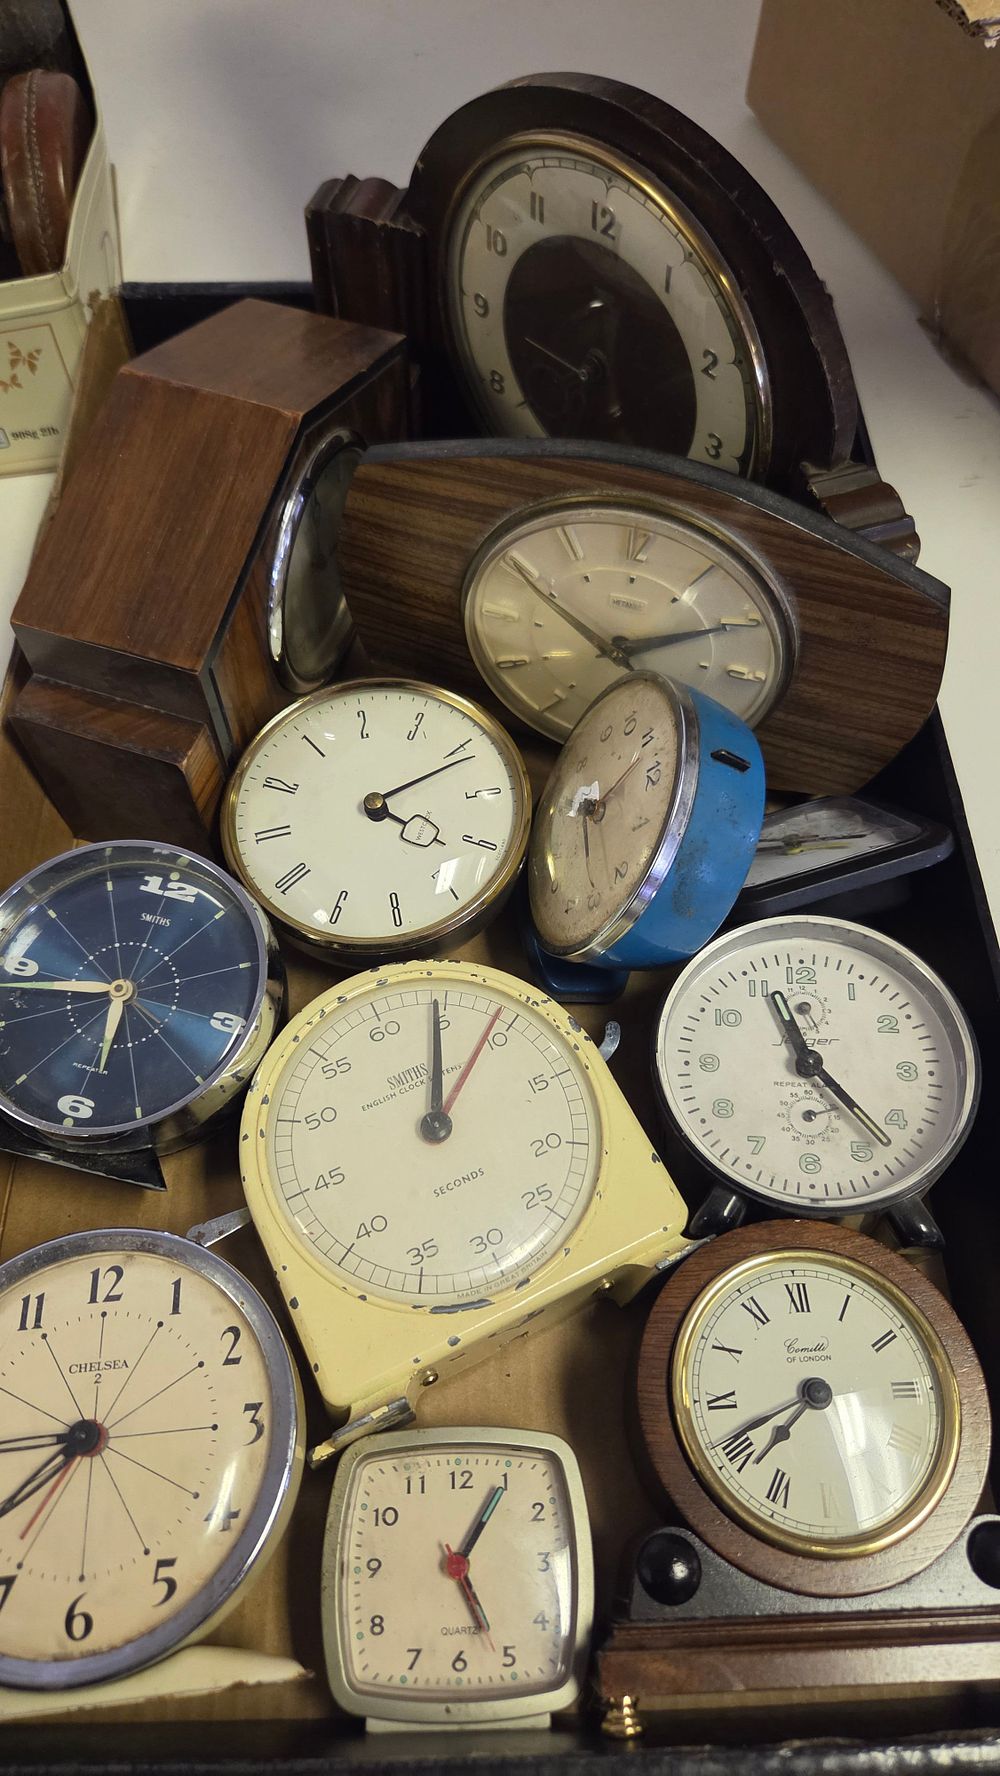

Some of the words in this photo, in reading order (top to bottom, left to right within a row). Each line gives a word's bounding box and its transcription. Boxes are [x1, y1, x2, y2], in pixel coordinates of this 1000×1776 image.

[530, 191, 545, 225] 11
[591, 199, 617, 241] 12
[486, 223, 508, 257] 10
[664, 263, 673, 295] 1
[474, 292, 490, 318] 9
[702, 349, 718, 380] 2
[490, 369, 505, 393] 8
[704, 432, 723, 460] 3
[357, 710, 370, 740] 2
[407, 712, 424, 741] 3
[600, 725, 613, 743] 9
[624, 710, 637, 736] 10
[301, 735, 326, 758] 1
[443, 738, 472, 760] 4
[641, 728, 654, 748] 11
[262, 776, 299, 795] 12
[646, 760, 662, 792] 12
[465, 787, 502, 799] 5
[254, 825, 291, 844] 11
[462, 834, 498, 851] 6
[275, 862, 312, 895] 10
[613, 861, 629, 884] 2
[139, 874, 200, 903] 12
[329, 890, 348, 925] 9
[389, 892, 403, 928] 8
[140, 912, 172, 927] SMITHS
[4, 956, 39, 977] 9
[786, 966, 817, 984] 12
[748, 979, 769, 998] 11
[847, 982, 856, 1001] 1
[209, 1011, 247, 1034] 3
[715, 1008, 742, 1027] 10
[877, 1014, 900, 1033] 2
[368, 1020, 401, 1043] 60
[486, 1032, 508, 1051] 10
[771, 1034, 841, 1047] Jeger
[321, 1056, 352, 1081] 55
[699, 1053, 720, 1072] 9
[896, 1061, 919, 1082] 3
[386, 1062, 429, 1091] SMITHS
[527, 1074, 550, 1095] 15
[57, 1094, 95, 1119] 6
[361, 1092, 397, 1112] ENGLISH
[398, 1078, 426, 1096] CLOCK
[304, 1106, 337, 1131] 50
[711, 1098, 734, 1119] 8
[885, 1109, 908, 1130] 4
[529, 1132, 562, 1158] 20
[747, 1135, 767, 1155] 7
[850, 1141, 873, 1162] 5
[799, 1152, 822, 1174] 6
[313, 1166, 346, 1192] 45
[433, 1167, 485, 1198] SECONDS
[520, 1183, 553, 1210] 25
[355, 1214, 388, 1240] 40
[406, 1238, 439, 1266] 35
[469, 1227, 504, 1254] 30
[86, 1264, 125, 1305] 12
[456, 1289, 482, 1299] MADE
[494, 1272, 521, 1290] GREAT
[169, 1277, 183, 1316] 1
[784, 1282, 811, 1313] XII
[17, 1292, 46, 1332] 11
[740, 1296, 771, 1330] XI
[220, 1325, 242, 1367] 2
[711, 1337, 743, 1363] X
[871, 1329, 898, 1354] II
[68, 1358, 130, 1375] CHELSEA
[799, 1354, 832, 1362] LONDON
[93, 1373, 103, 1385] 2
[705, 1390, 738, 1411] IX
[890, 1380, 922, 1402] III
[242, 1402, 265, 1446] 3
[405, 1475, 425, 1494] 11
[449, 1470, 474, 1490] 12
[501, 1472, 509, 1491] 1
[765, 1467, 791, 1509] VII
[373, 1506, 399, 1526] 10
[530, 1502, 546, 1522] 2
[366, 1557, 382, 1578] 9
[537, 1551, 551, 1572] 3
[151, 1556, 178, 1608] 5
[64, 1591, 94, 1642] 6
[369, 1614, 385, 1636] 8
[533, 1610, 550, 1631] 4
[440, 1626, 479, 1636] QUARTZ
[406, 1648, 423, 1670] 7
[451, 1650, 468, 1672] 6
[502, 1645, 516, 1667] 5
